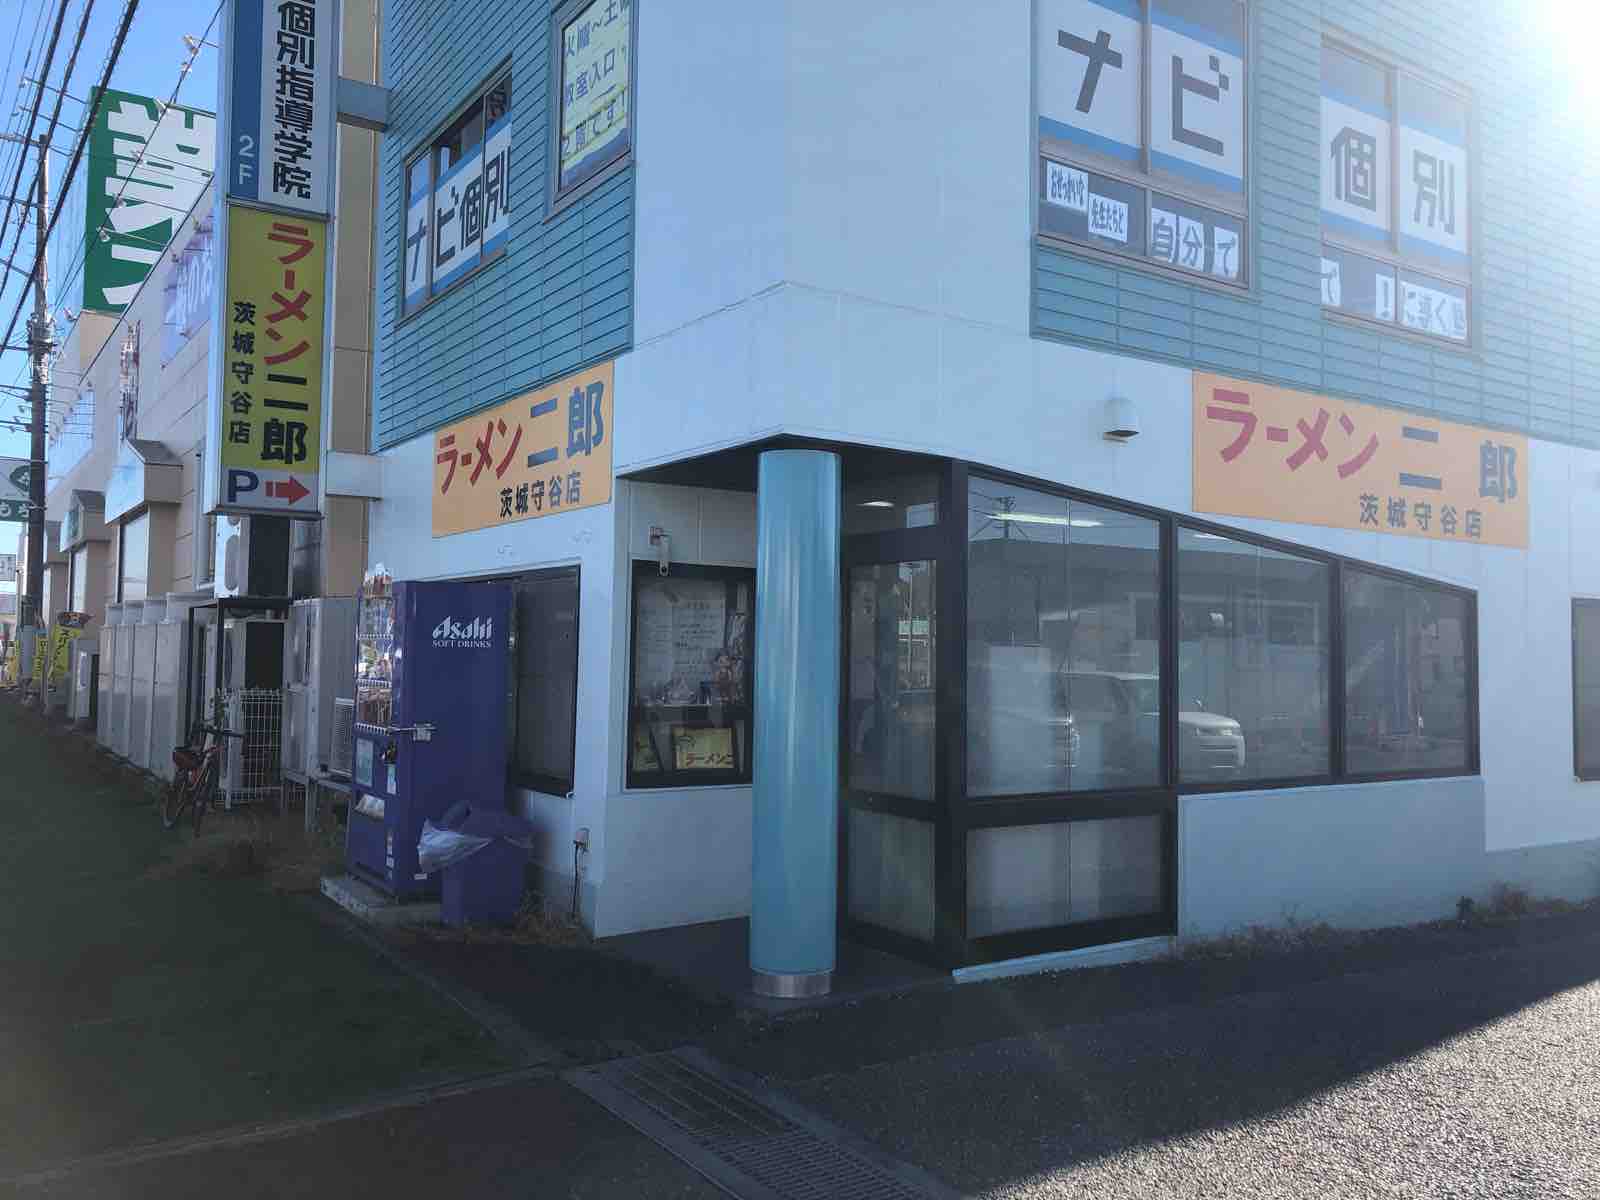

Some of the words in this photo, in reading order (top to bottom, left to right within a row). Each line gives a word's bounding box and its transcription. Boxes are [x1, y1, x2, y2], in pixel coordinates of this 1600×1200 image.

[272, 0, 317, 200] 個別指導学院
[1056, 29, 1229, 156] ナビ
[1329, 125, 1456, 236] 個別
[238, 134, 256, 186] 2F
[407, 145, 513, 282] ナビ個別
[228, 300, 257, 446] 茨城守谷店
[260, 221, 314, 465] ラーメン二郎
[228, 469, 259, 503] P
[435, 380, 605, 495] ラーメン二郎
[499, 471, 582, 518] 茨城守谷店
[1206, 387, 1519, 503] ラーメン二郎
[1358, 492, 1483, 539] 茨城守谷店
[432, 615, 493, 640] Asahi
[432, 639, 455, 649] SOFT
[457, 639, 492, 649] DRINKS
